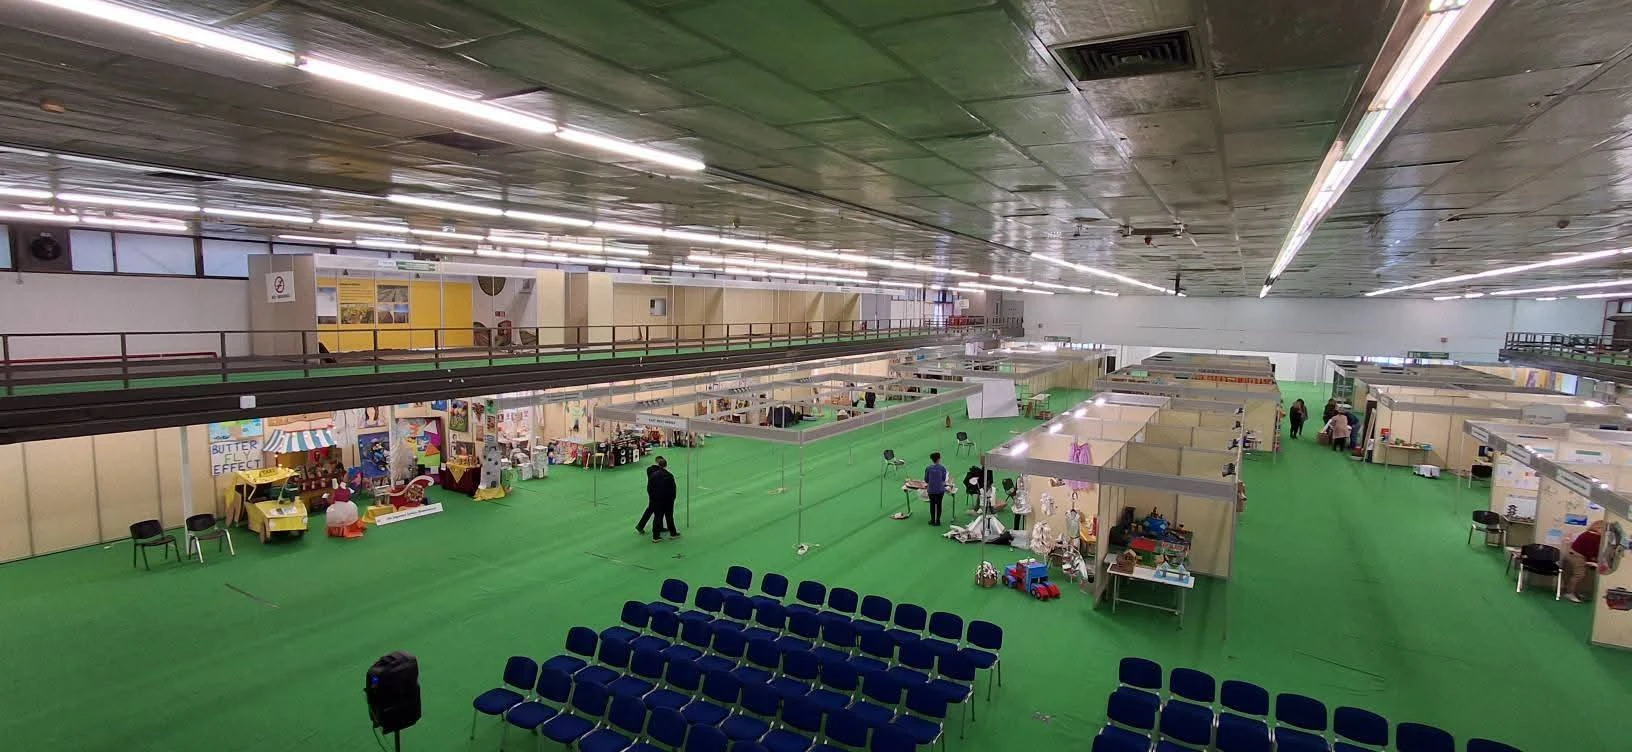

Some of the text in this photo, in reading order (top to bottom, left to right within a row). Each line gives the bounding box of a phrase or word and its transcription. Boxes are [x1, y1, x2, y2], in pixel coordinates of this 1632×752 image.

[212, 439, 257, 455] BUTTER
[225, 451, 250, 464] FLY
[213, 458, 260, 475] EFFECT
